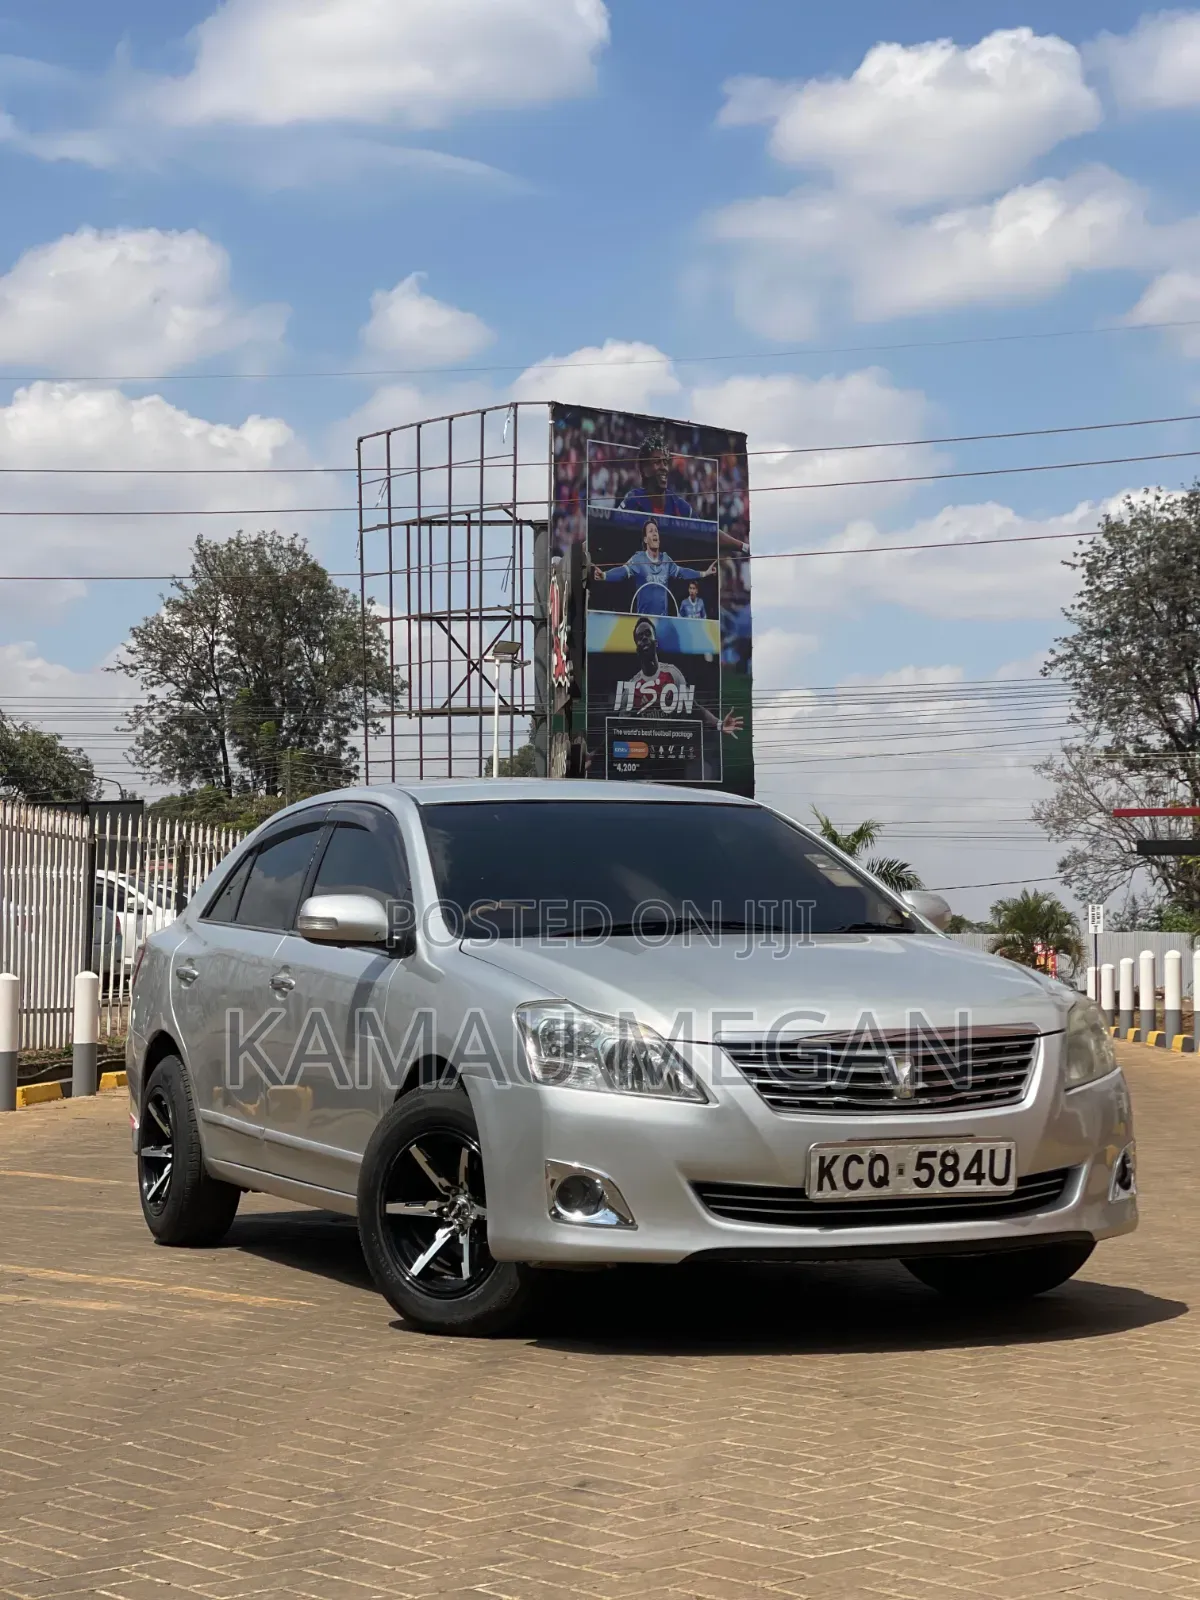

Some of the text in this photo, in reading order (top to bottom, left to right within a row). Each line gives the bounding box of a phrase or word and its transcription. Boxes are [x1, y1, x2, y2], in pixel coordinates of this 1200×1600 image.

[614, 679, 695, 714] IT'S ON
[613, 728, 622, 736] The
[672, 731, 693, 739] package
[616, 763, 637, 772] 4,200
[816, 1148, 1012, 1191] KCQ 584U
